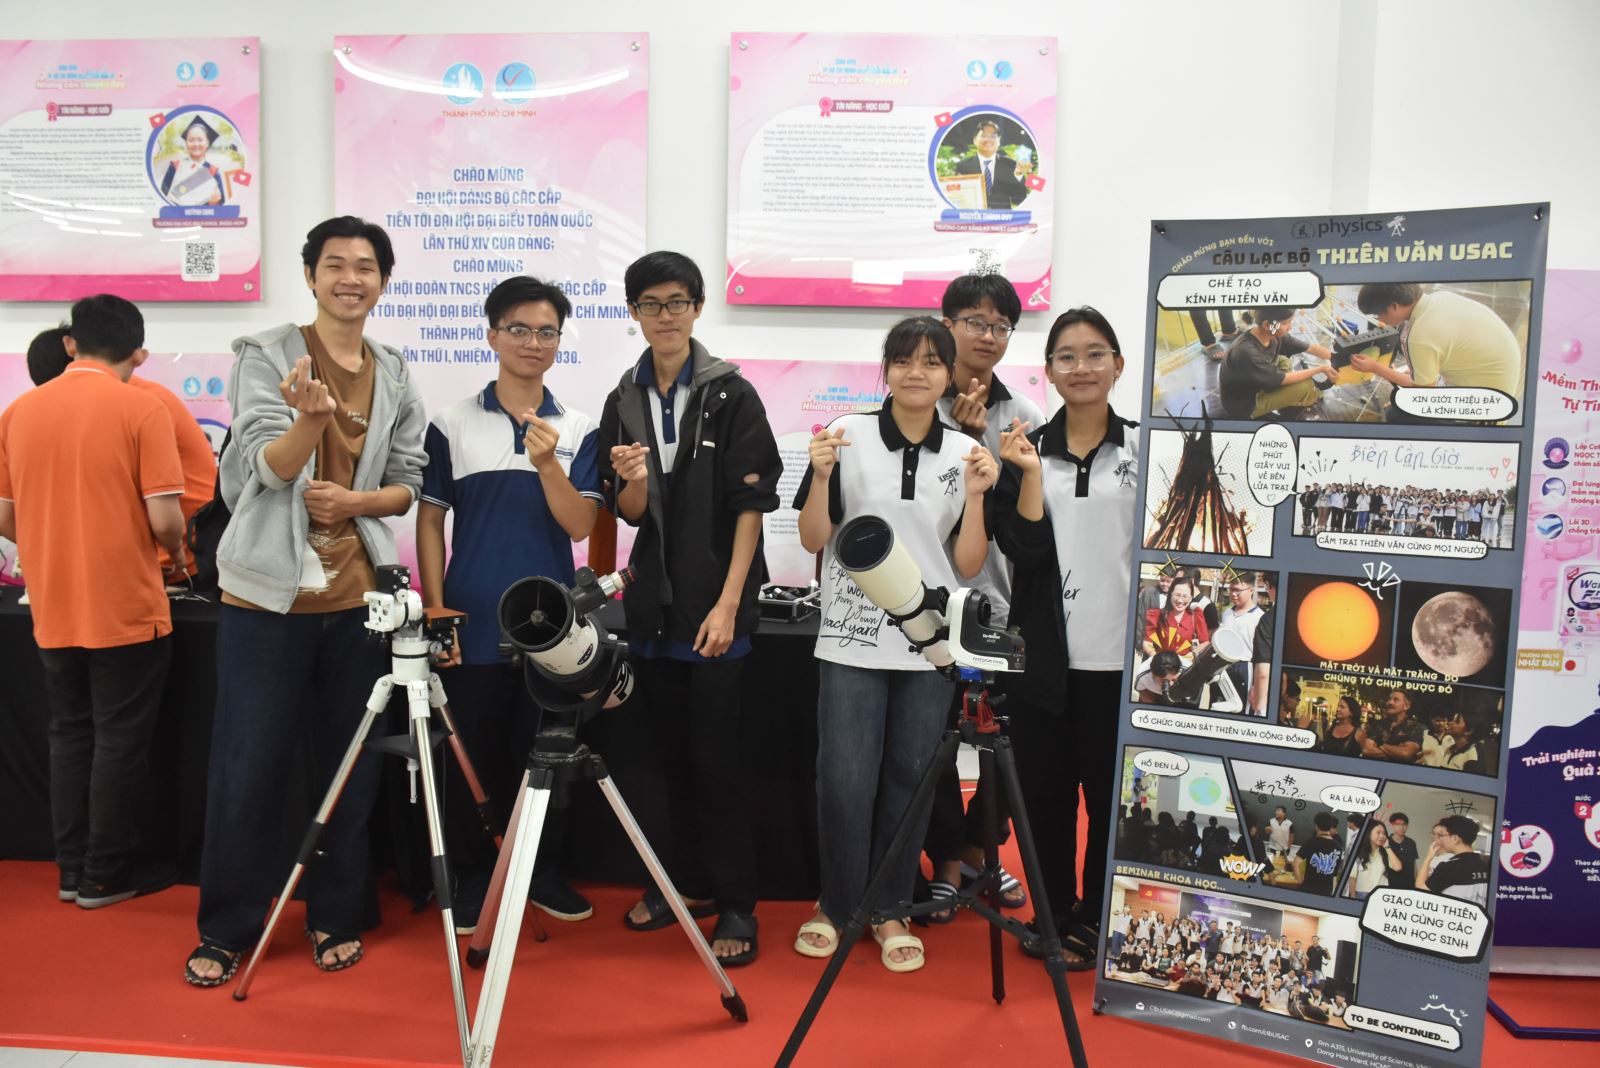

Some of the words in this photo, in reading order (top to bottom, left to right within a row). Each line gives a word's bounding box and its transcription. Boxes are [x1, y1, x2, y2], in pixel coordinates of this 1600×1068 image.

[453, 167, 485, 182] CHÀO
[386, 212, 411, 228] TIẾN
[434, 214, 453, 230] ĐẠI
[456, 212, 475, 230] HỘI
[478, 214, 496, 230] ĐẠI
[527, 212, 556, 228] TOÀN
[561, 210, 593, 228] QUỐC
[1318, 217, 1382, 238] physics
[424, 234, 442, 250] LẦN
[472, 236, 490, 250] XIV
[1219, 237, 1236, 248] BẠN
[1238, 234, 1255, 244] ĐẾN
[1258, 236, 1274, 246] VỚI
[1212, 250, 1245, 266] CÂU
[1250, 252, 1283, 268] LẠC
[1287, 247, 1310, 268] BỘ
[1317, 242, 1390, 265] THIÊN
[1396, 240, 1444, 262] VĂN
[1450, 242, 1513, 260] USAC
[453, 258, 485, 272] CHÀO
[394, 280, 412, 298] HỘI
[416, 280, 447, 295] ĐOÀN
[450, 282, 480, 295] TNCS
[583, 279, 607, 296] CẤP
[1208, 274, 1234, 288] CHẾ
[1238, 279, 1262, 290] TẠO
[1186, 292, 1216, 304] KÍNH
[1221, 291, 1258, 304] THIÊN
[1264, 291, 1288, 303] VĂN
[398, 304, 416, 320] ĐẠI
[419, 302, 437, 320] HỘI
[440, 304, 458, 320] ĐẠI
[576, 303, 595, 318] CHÍ
[598, 306, 630, 318] MINH
[420, 324, 458, 340] THÀNH
[461, 323, 484, 340] PHỐ
[402, 346, 418, 362] ẦN
[454, 347, 492, 366] NHIỆM
[1542, 370, 1576, 390] Mềm
[1430, 394, 1452, 403] GIỚI
[1455, 396, 1480, 405] THIỆU
[1482, 395, 1500, 404] ĐÂY
[1562, 396, 1580, 414] Tự
[1422, 406, 1432, 414] LÀ
[1260, 440, 1288, 448] NHỮNG
[1263, 450, 1283, 458] PHÚT
[1432, 446, 1460, 466] Giờ
[1318, 536, 1336, 545] CẮM
[1338, 538, 1357, 546] TRẠI
[1360, 537, 1385, 548] THIÊN
[1388, 538, 1404, 549] VĂN
[1407, 540, 1432, 551] CÙNG
[1434, 544, 1452, 554] MỌI
[1454, 544, 1485, 554] NGƯỜI
[1320, 660, 1338, 670] MẶT
[1342, 662, 1366, 672] TRỜI
[1368, 664, 1380, 674] VÀ
[1384, 667, 1402, 678] MẶT
[1406, 669, 1438, 680] TRĂNG
[1324, 672, 1357, 684] CHÚNG
[1360, 676, 1374, 686] TỚ
[1376, 679, 1403, 690] CHỤP
[1406, 682, 1436, 693] ĐƯỢC
[1438, 684, 1453, 694] ĐÓ
[1151, 716, 1173, 727] CHỨC
[1175, 720, 1197, 730] QUAN
[1199, 722, 1213, 732] SÁT
[1216, 725, 1239, 735] THIÊN
[1241, 728, 1258, 738] VĂN
[1260, 729, 1283, 741] CỘNG
[1286, 732, 1310, 744] ĐỒNG
[1155, 762, 1170, 770] ĐEN
[1522, 752, 1550, 767] Trải
[1552, 748, 1596, 763] nghiệm
[1562, 762, 1594, 781] Quà
[1578, 806, 1587, 816] 2
[1116, 866, 1160, 880] SEMINAR
[1163, 872, 1191, 885] KHOA
[1219, 858, 1266, 876] WOW!
[1382, 894, 1412, 906] GIAO
[1416, 901, 1438, 912] LƯU
[1442, 905, 1478, 921] THIÊN
[1384, 908, 1407, 920] VĂN
[1410, 914, 1444, 928] CÙNG
[1448, 921, 1472, 935] CÁC
[1384, 924, 1407, 936] BẠN
[1411, 928, 1436, 942] HỌC
[1440, 935, 1468, 950] SINH
[1351, 1013, 1364, 1023] TO
[1367, 1016, 1378, 1026] BE
[1317, 1048, 1334, 1058] Dong
[1348, 1047, 1378, 1060] University
